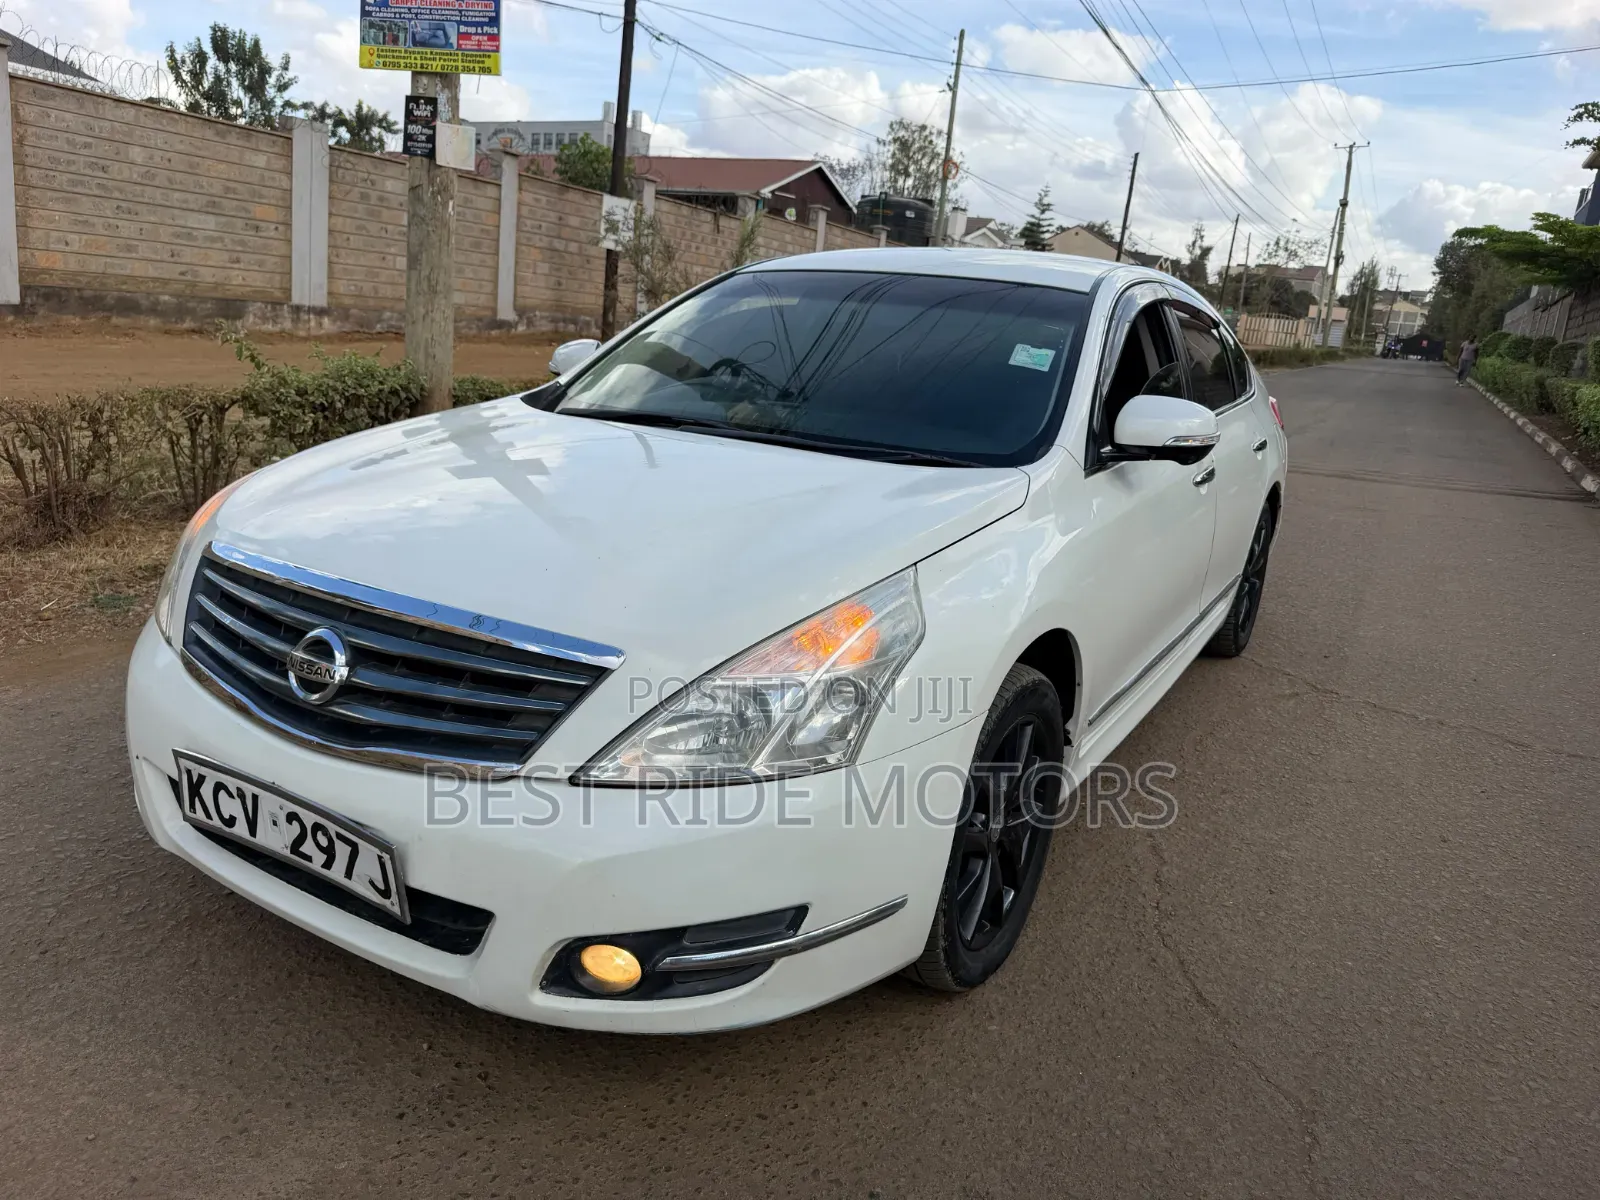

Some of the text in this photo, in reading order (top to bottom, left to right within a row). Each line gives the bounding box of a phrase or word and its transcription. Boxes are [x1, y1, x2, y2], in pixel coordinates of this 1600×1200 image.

[420, 0, 456, 8] CLEANING
[460, 25, 476, 34] Drop
[483, 26, 498, 34] Pick
[461, 51, 491, 59] Opposite
[382, 60, 401, 68] 0795
[403, 61, 418, 69] 333
[420, 62, 434, 70] 821
[477, 66, 492, 74] 705
[407, 125, 422, 134] 100
[289, 656, 337, 680] NISSAN
[184, 765, 259, 839] KCV
